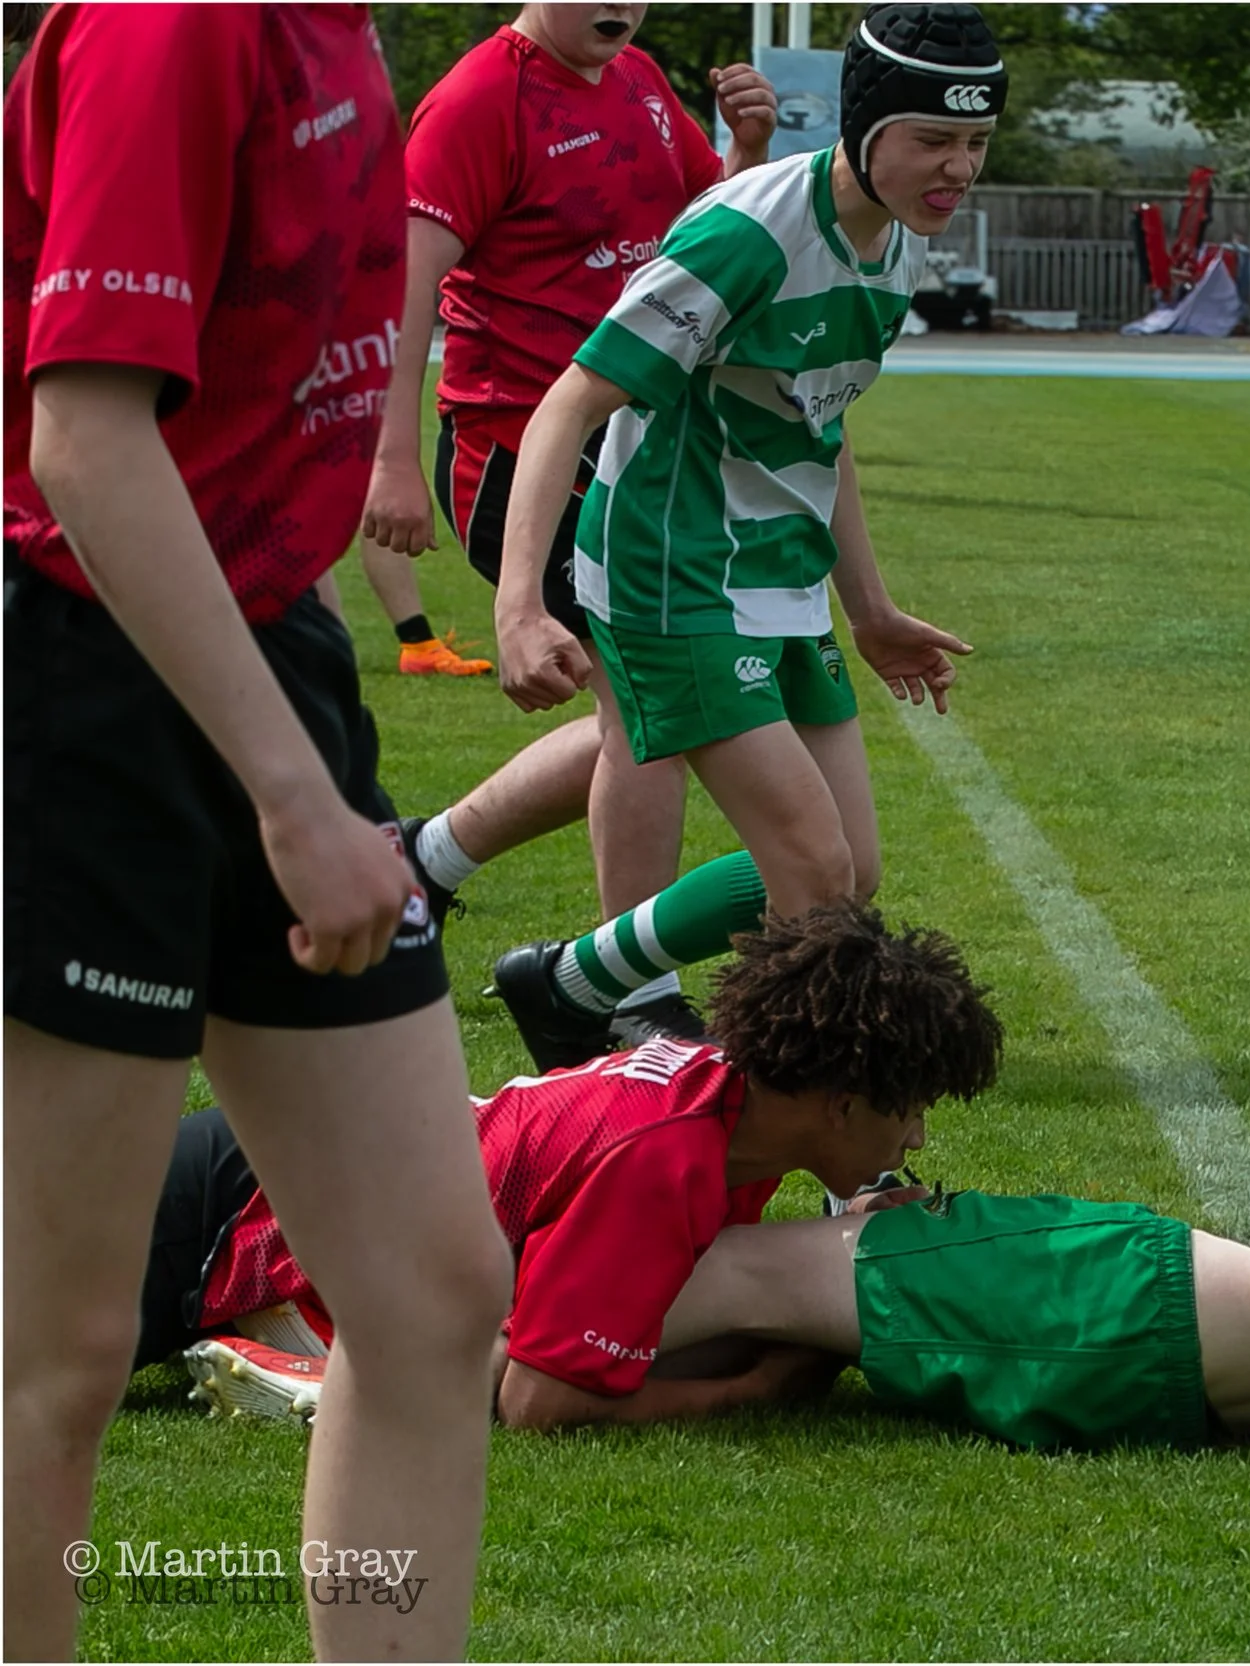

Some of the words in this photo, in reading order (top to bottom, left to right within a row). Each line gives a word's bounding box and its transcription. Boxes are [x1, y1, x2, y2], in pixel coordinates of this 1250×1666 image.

[409, 198, 453, 223] OLSEN
[102, 269, 194, 305] OLSEN
[84, 967, 194, 1010] SAMURAI
